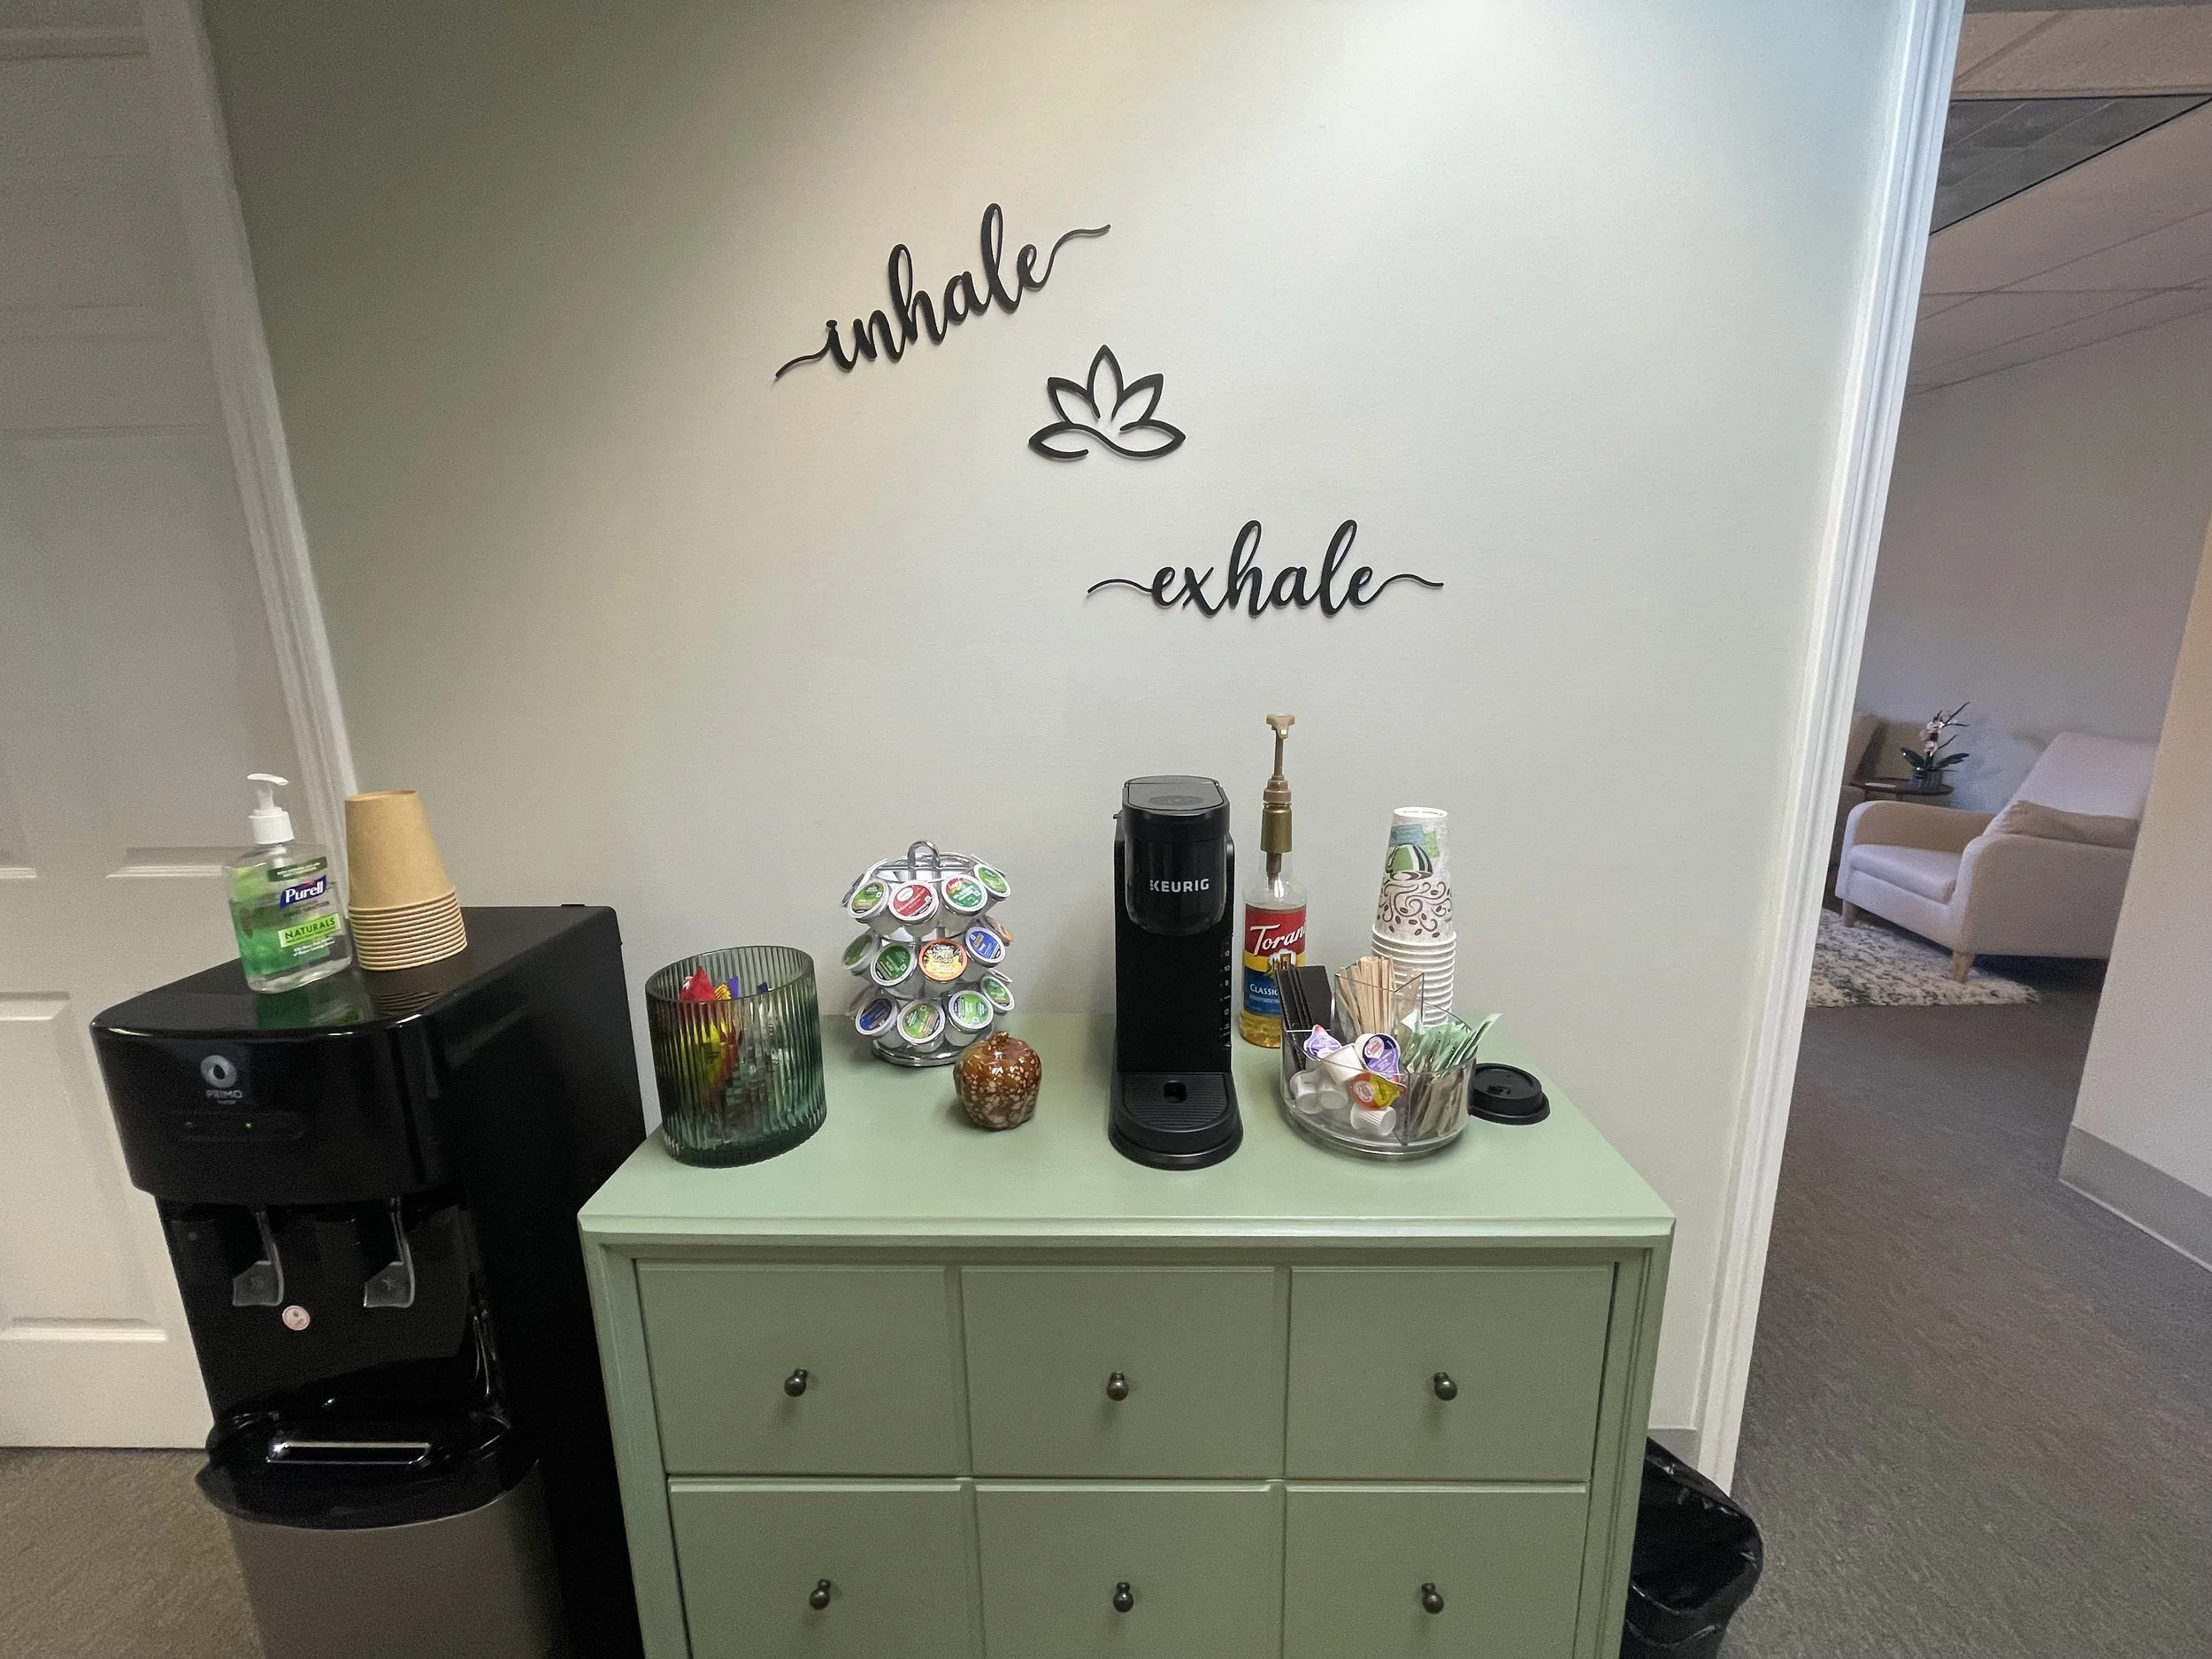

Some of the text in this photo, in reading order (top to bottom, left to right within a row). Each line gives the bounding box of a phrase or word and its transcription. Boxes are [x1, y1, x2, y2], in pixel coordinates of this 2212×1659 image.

[774, 202, 1110, 380] inhale
[1087, 518, 1444, 617] exhale
[285, 880, 325, 903] Purell
[1149, 878, 1210, 893] KEURIG
[284, 918, 336, 939] NATURALS
